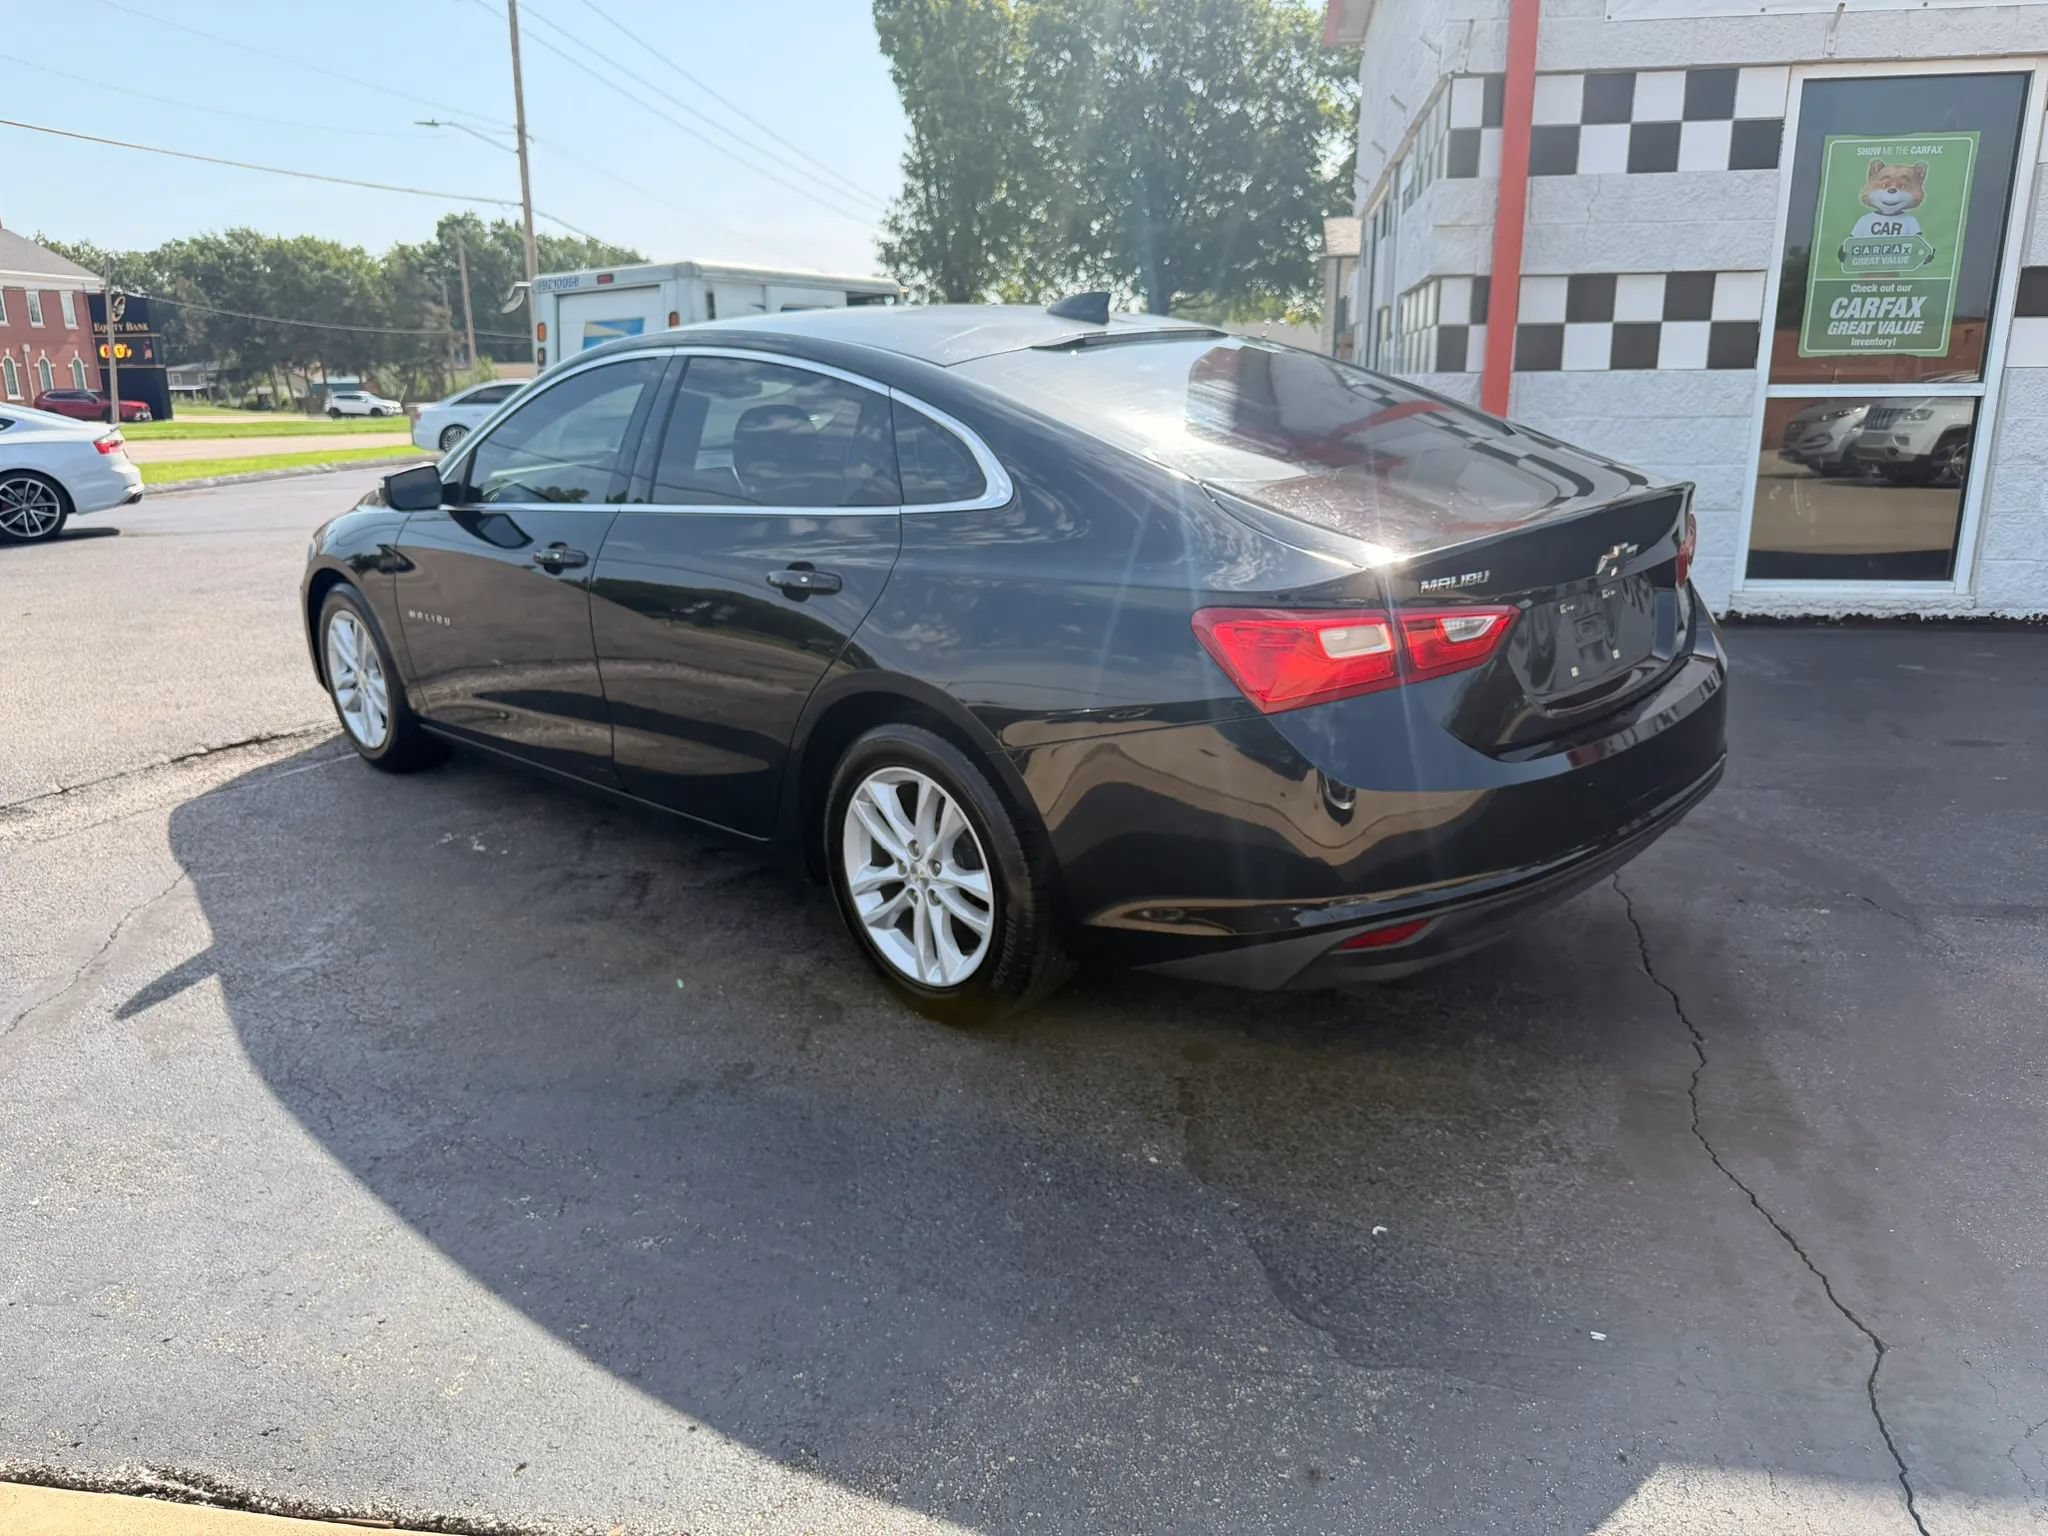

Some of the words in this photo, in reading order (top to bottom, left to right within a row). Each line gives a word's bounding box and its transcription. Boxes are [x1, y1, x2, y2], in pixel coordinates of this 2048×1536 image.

[1857, 147, 1881, 156] SHOW
[1896, 146, 1909, 155] THE
[1910, 145, 1943, 154] CARFAX
[1871, 221, 1903, 235] CAR
[1852, 243, 1912, 255] CARFAX
[1852, 257, 1880, 265] GREAT
[1881, 256, 1910, 264] VALUE
[1850, 283, 1878, 293] Check
[1879, 284, 1895, 292] out
[1829, 296, 1928, 319] CARFAX
[1827, 321, 1877, 335] GREAT
[1876, 320, 1925, 334] VALUE
[1850, 337, 1897, 348] Inventory!
[1420, 569, 1490, 594] MALIBU
[408, 609, 451, 626] MALIBU
